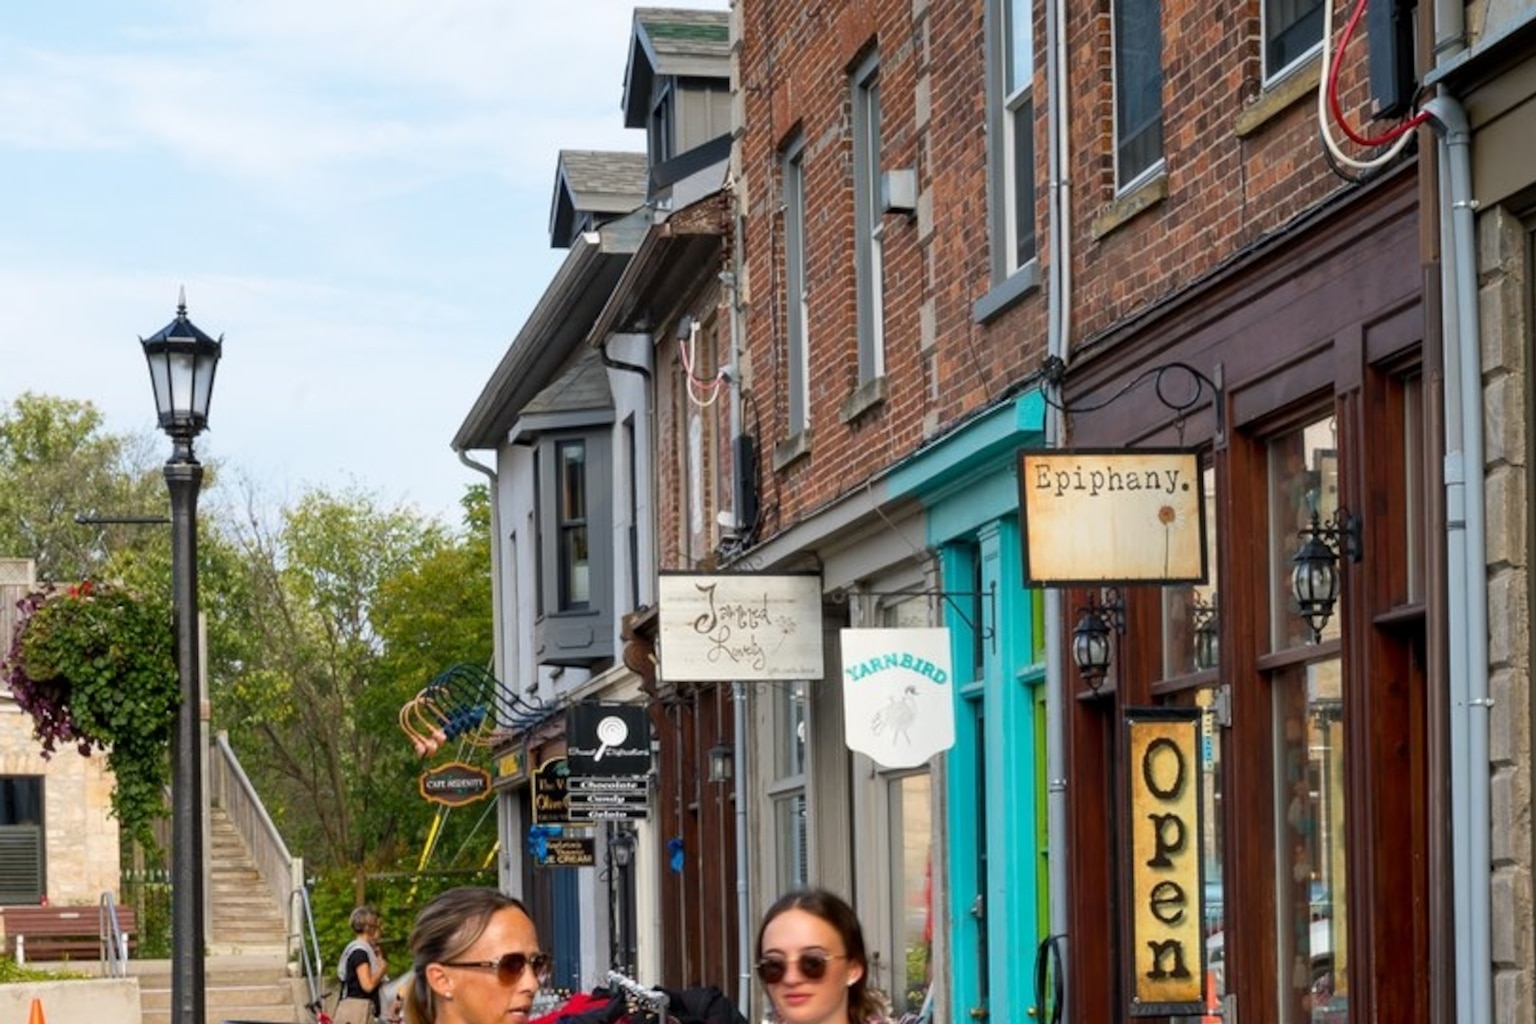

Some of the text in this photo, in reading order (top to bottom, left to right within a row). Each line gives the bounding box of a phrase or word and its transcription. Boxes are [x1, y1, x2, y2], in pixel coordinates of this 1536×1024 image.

[1035, 464, 1189, 496] Epiphany.
[845, 652, 947, 686] YARNBIRD
[580, 780, 638, 789] Chocolate
[587, 795, 625, 804] Candy
[588, 810, 627, 818] Gelato
[1142, 736, 1190, 979] Open
